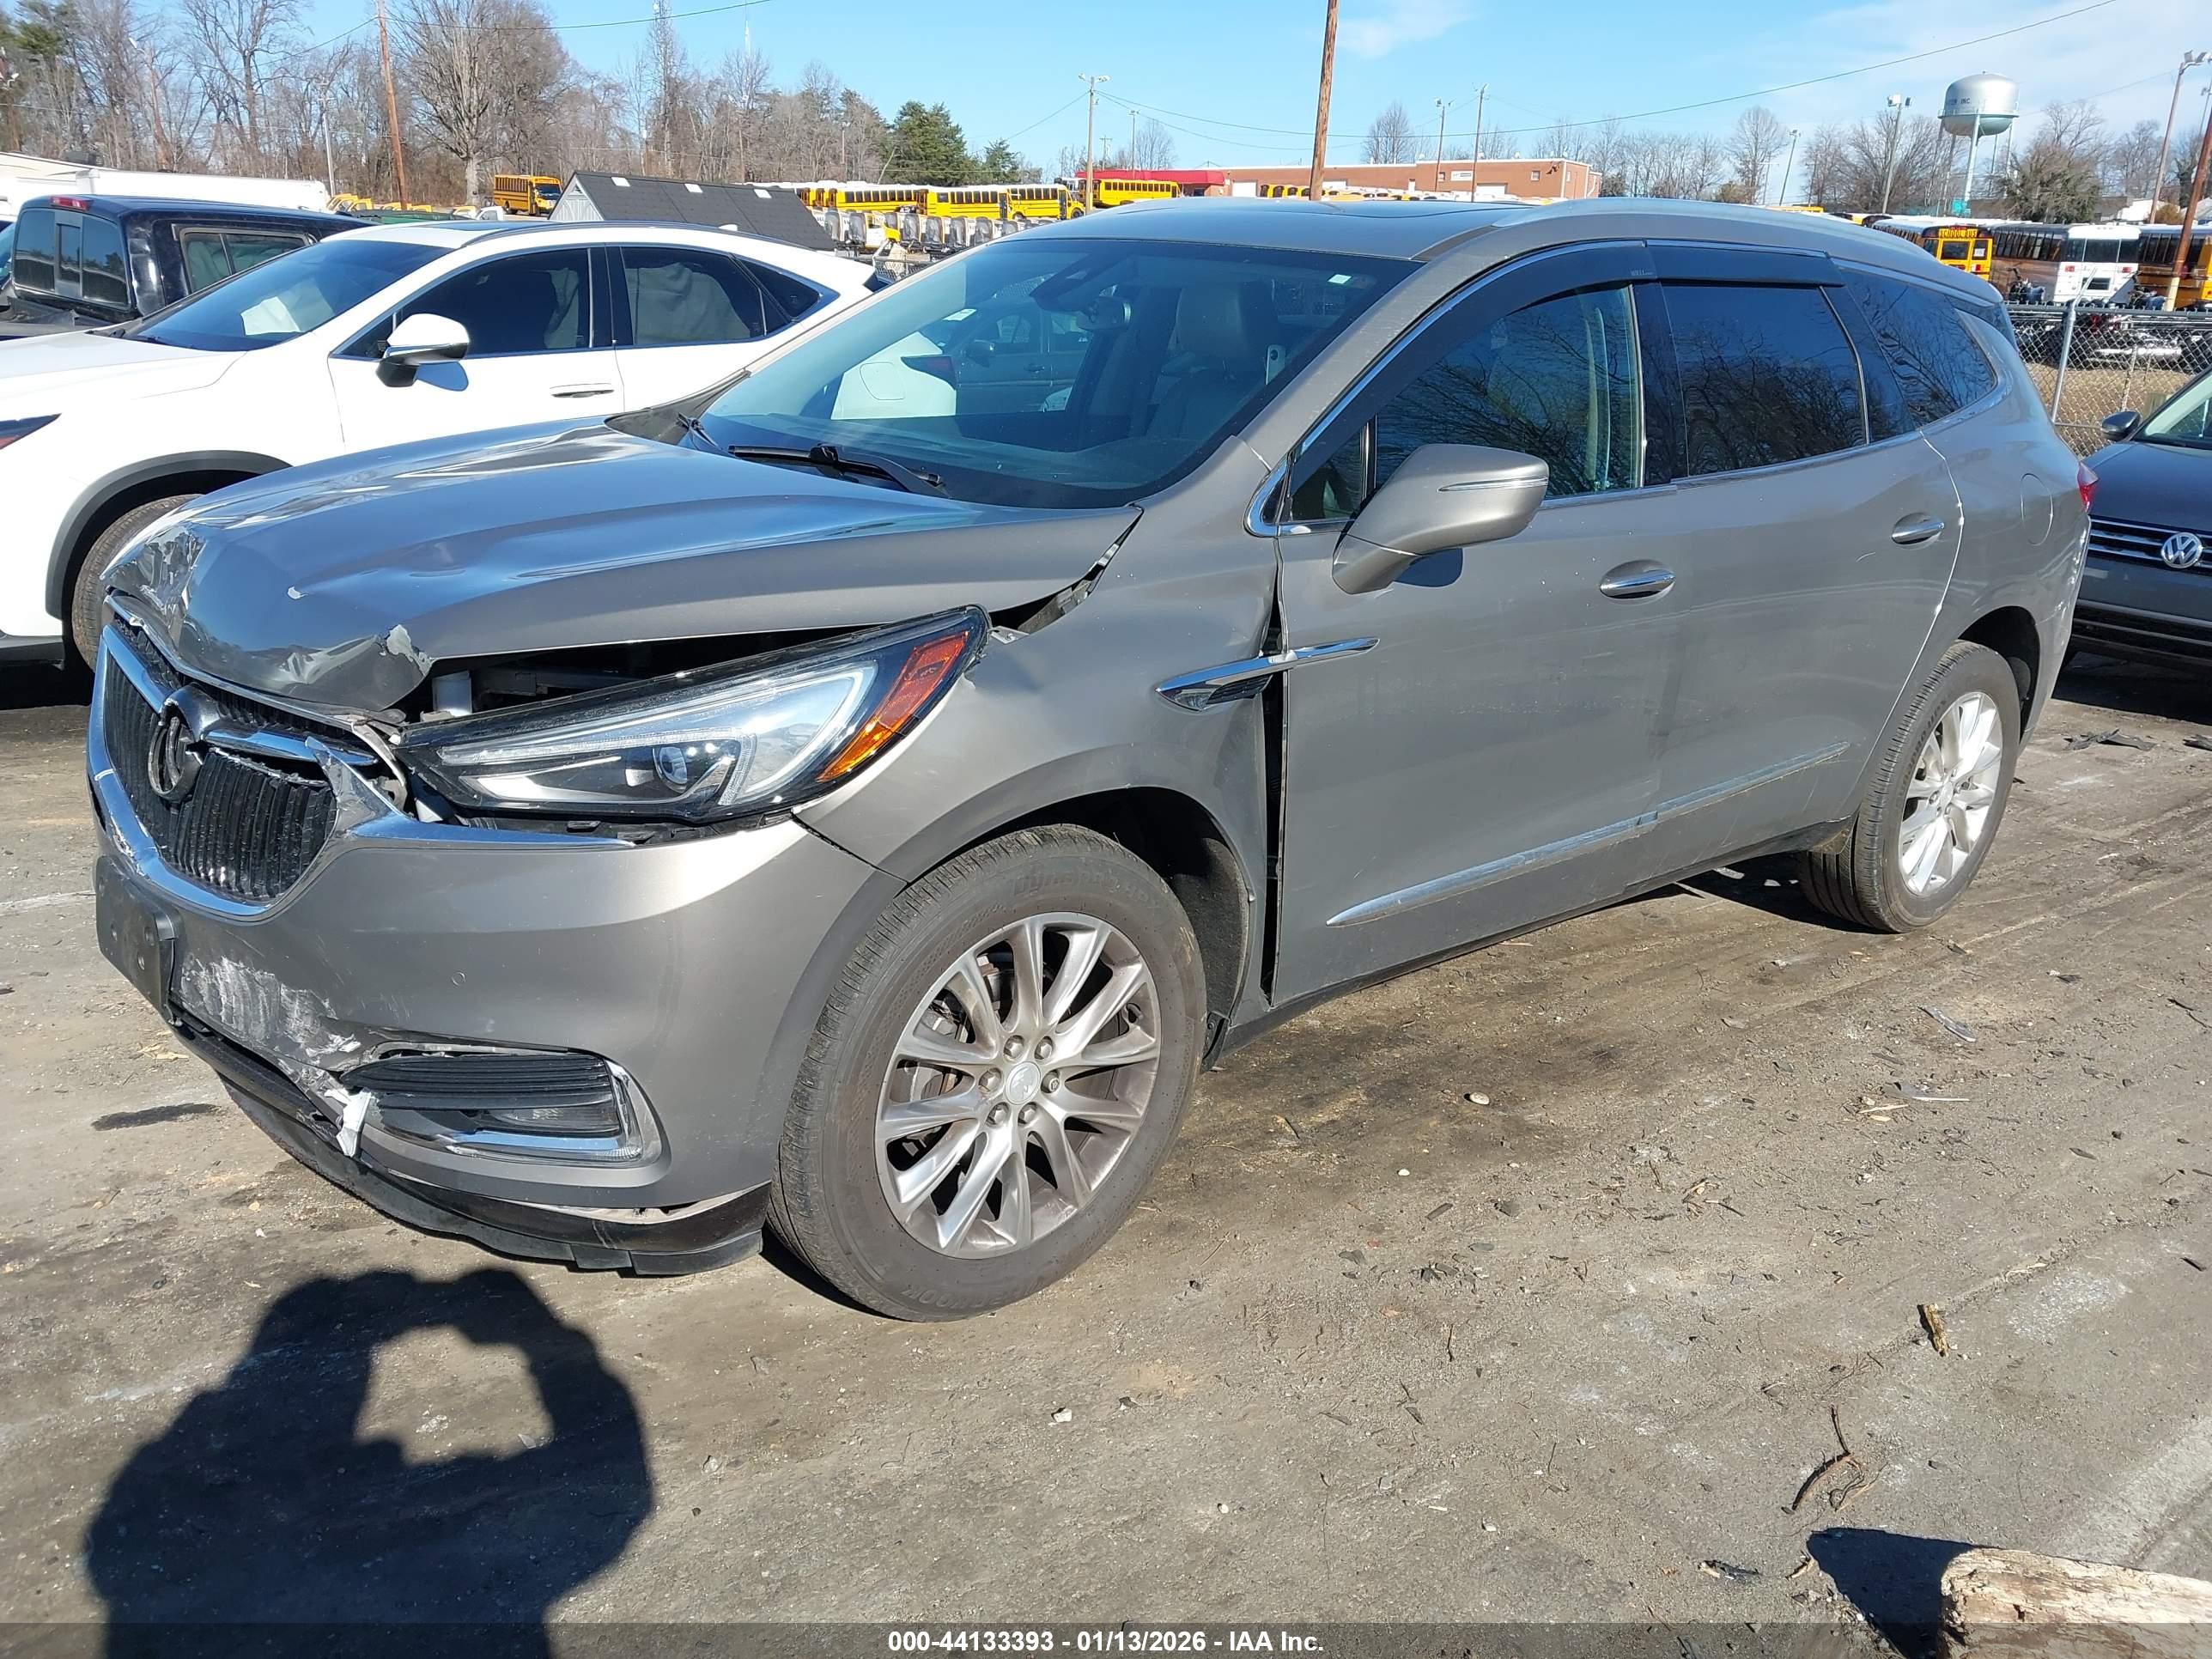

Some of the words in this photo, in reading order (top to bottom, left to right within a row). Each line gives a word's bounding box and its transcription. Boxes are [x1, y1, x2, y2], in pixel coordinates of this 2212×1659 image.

[1939, 228, 1964, 237] SCHOOL
[1965, 228, 1978, 237] BUS
[2163, 534, 2201, 567] VW
